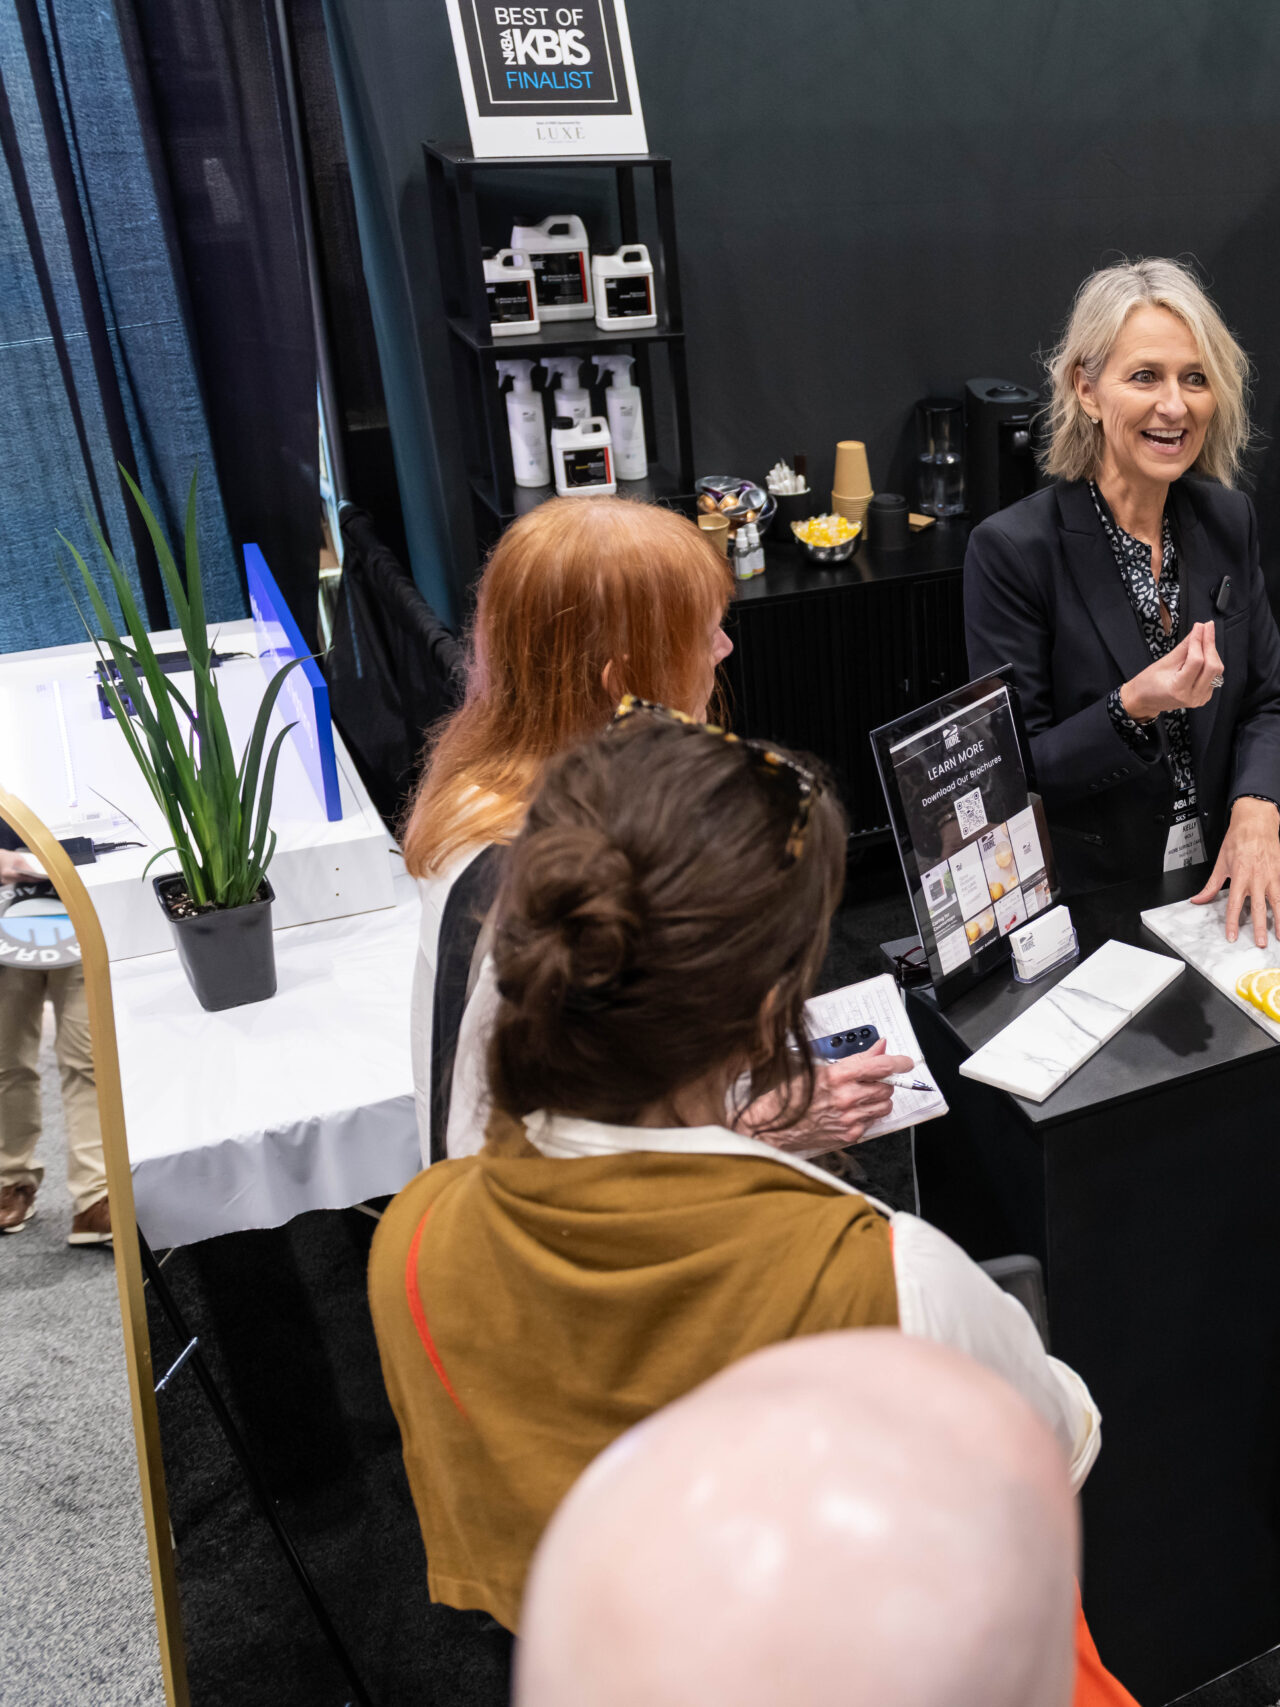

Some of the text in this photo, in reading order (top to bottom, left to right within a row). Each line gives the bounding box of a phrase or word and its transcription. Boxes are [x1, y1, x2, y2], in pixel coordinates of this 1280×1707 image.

[494, 7, 584, 26] BEST OF
[499, 29, 517, 65] NKBA
[514, 28, 591, 65] KBIS
[506, 71, 594, 89] FINALIST
[536, 126, 586, 141] LUXE
[928, 741, 985, 781] LEARN MORE
[921, 755, 1002, 808] Download Our Brochures
